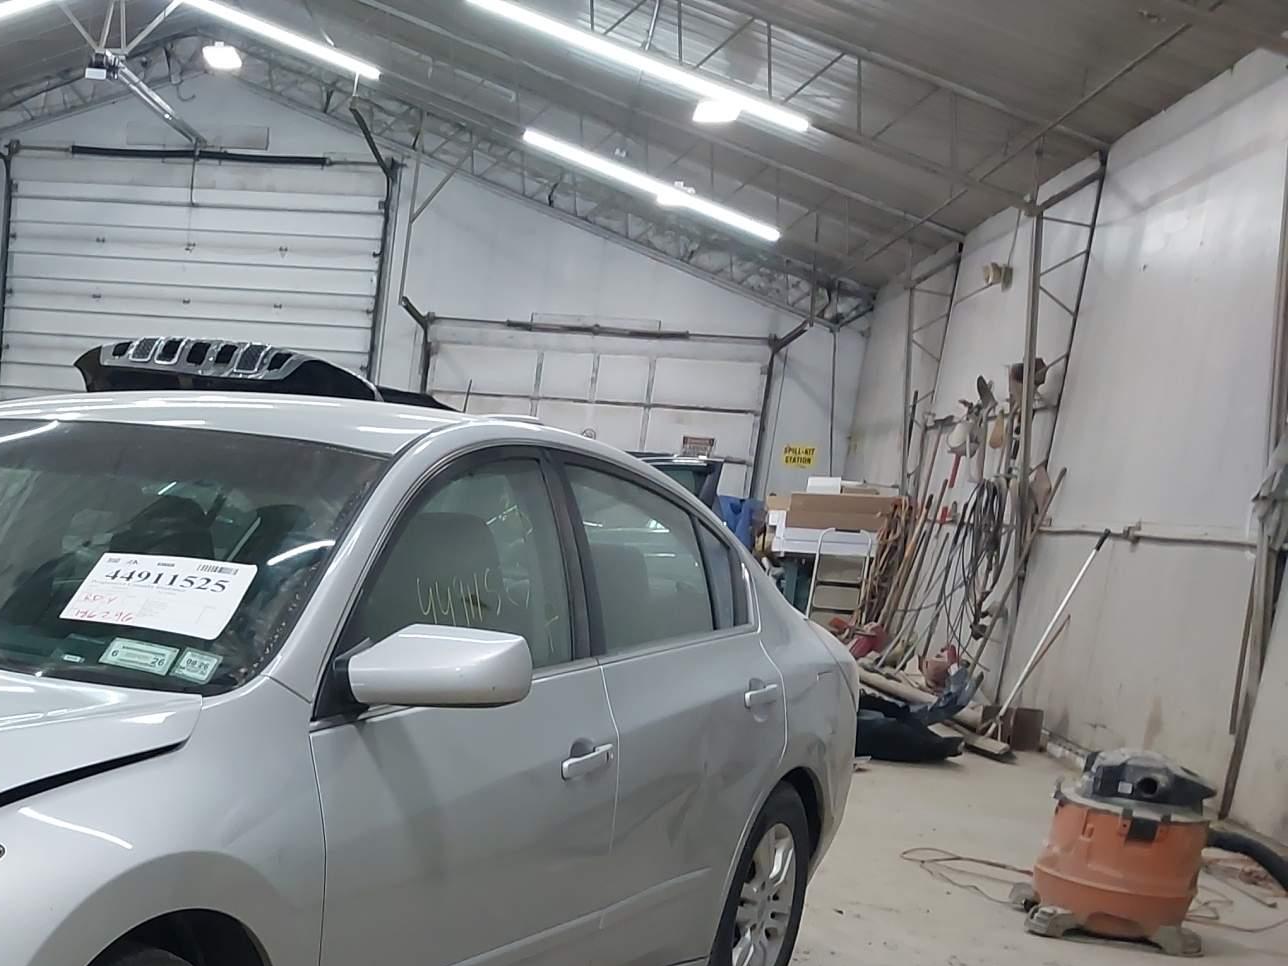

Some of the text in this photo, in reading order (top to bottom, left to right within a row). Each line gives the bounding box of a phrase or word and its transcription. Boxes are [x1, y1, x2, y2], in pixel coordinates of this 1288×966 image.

[783, 447, 816, 456] SPILL-KIT
[784, 456, 812, 464] STATION
[104, 568, 230, 594] 44911525
